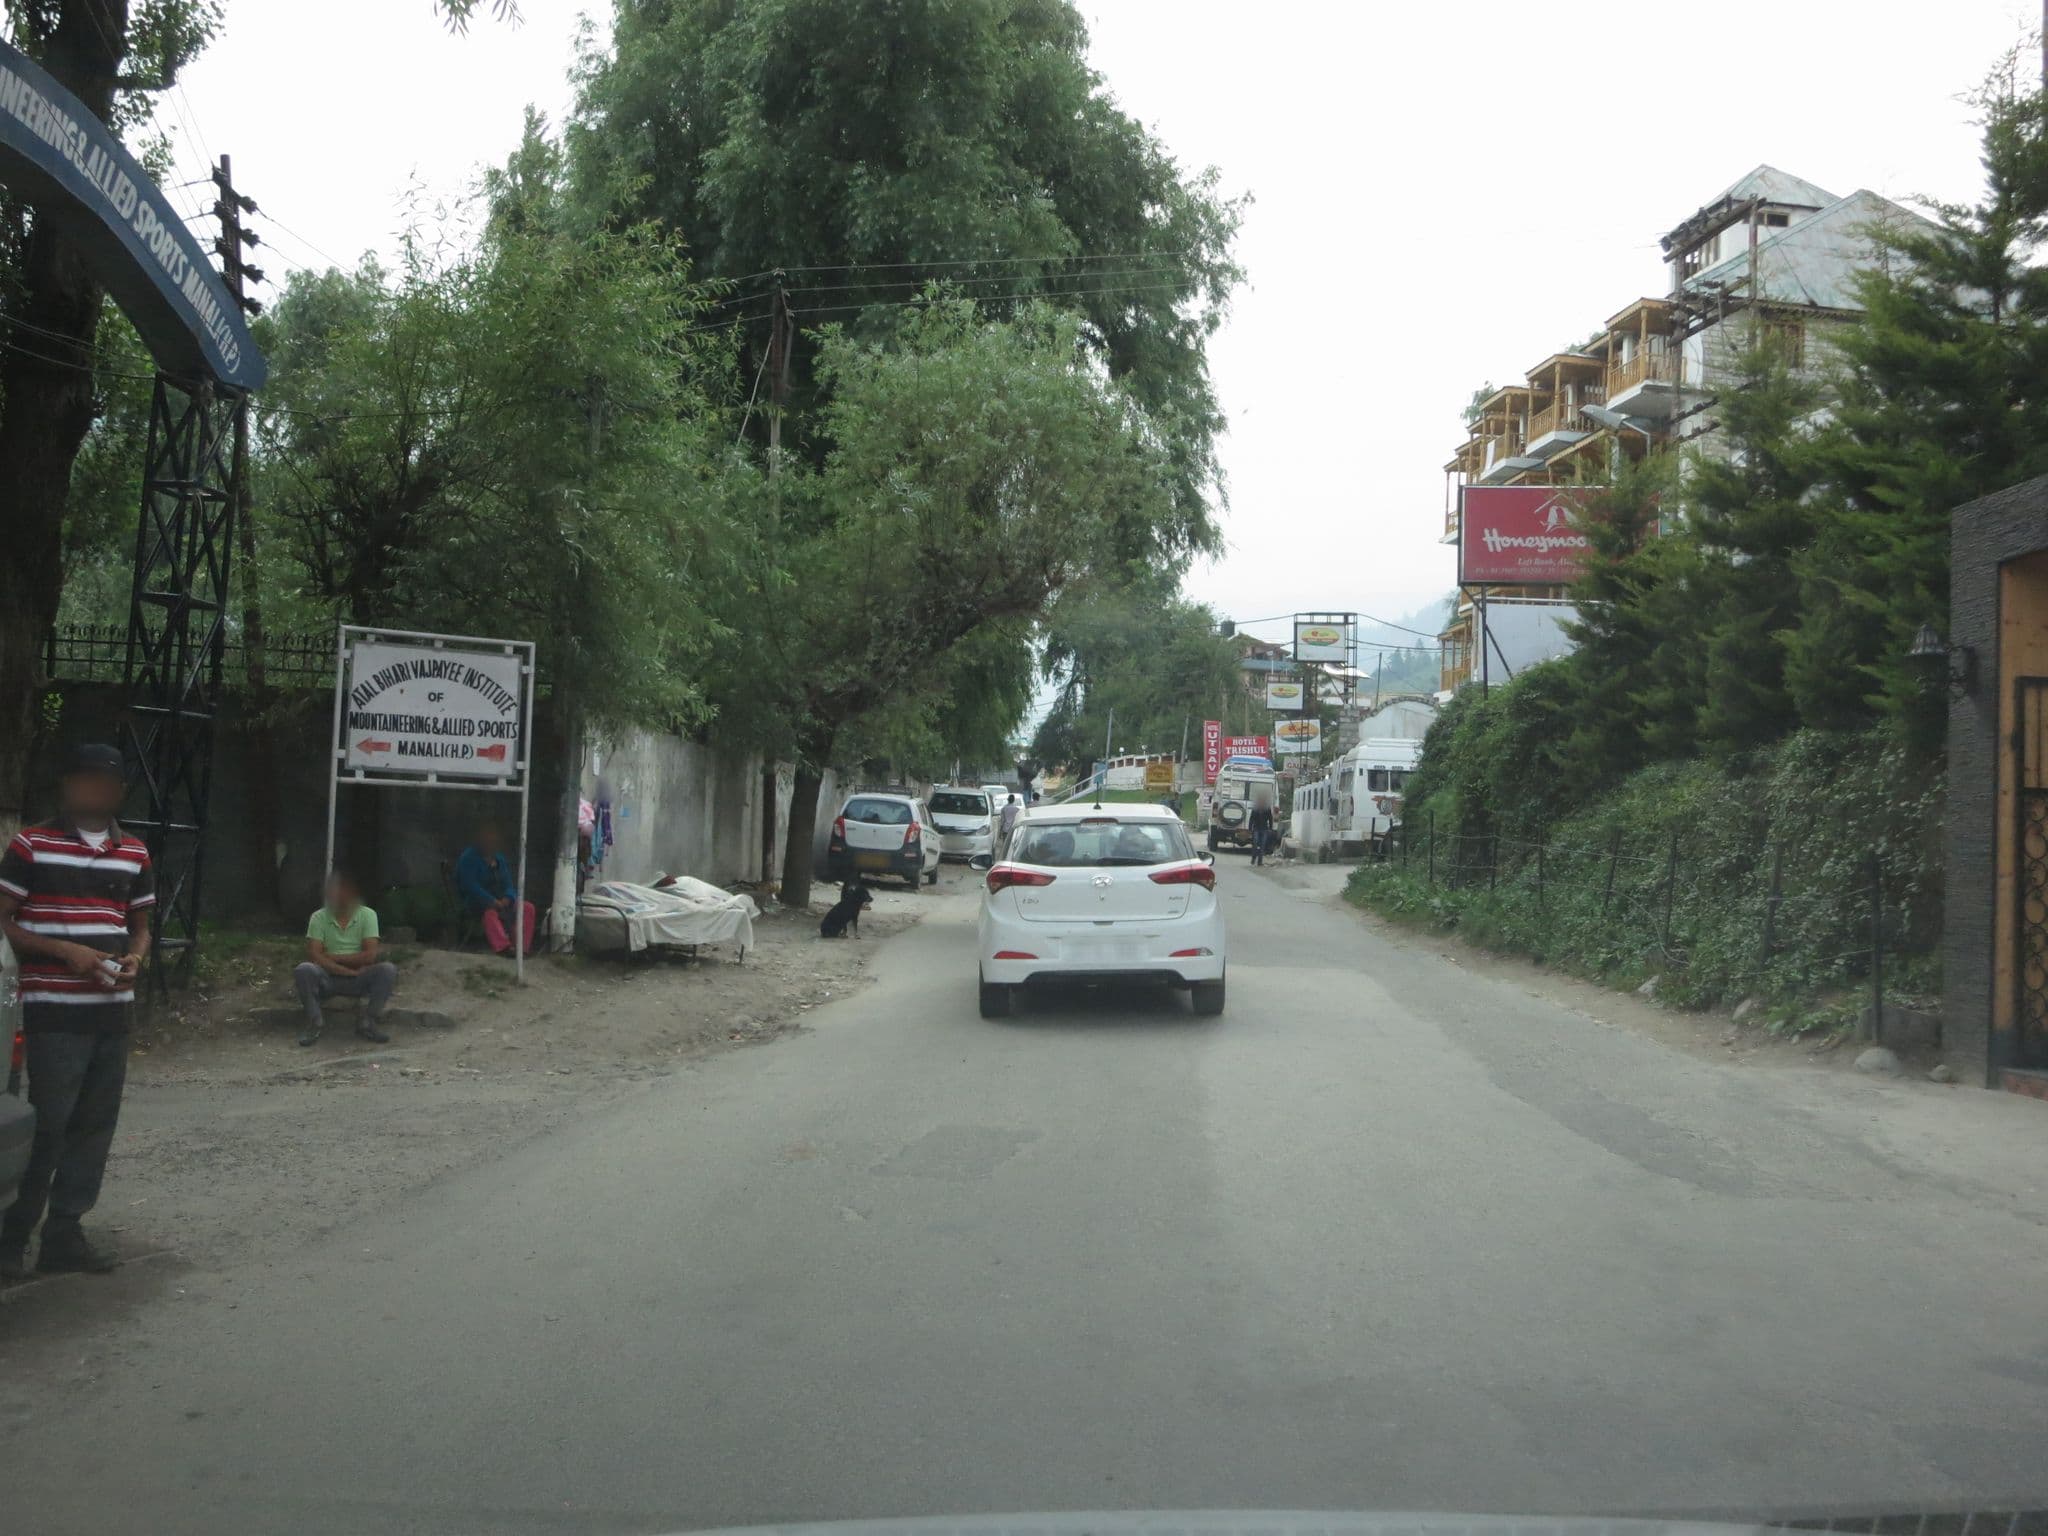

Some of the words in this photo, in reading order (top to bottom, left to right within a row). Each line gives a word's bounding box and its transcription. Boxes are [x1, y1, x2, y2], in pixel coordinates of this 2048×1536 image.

[133, 200, 189, 285] SPORTS
[1482, 527, 1588, 553] Honeymoo
[351, 680, 380, 710] ATAL
[372, 662, 412, 692] BIHARI
[410, 659, 465, 683] VAJPAYEE
[462, 667, 518, 717] INSTITUTE
[427, 692, 445, 703] OF
[440, 717, 475, 737] ALLIED
[477, 719, 518, 739] SPORTS
[1207, 731, 1218, 771] UTSAV
[1225, 746, 1266, 755] TRISHUL
[1232, 738, 1258, 746] HOTEL
